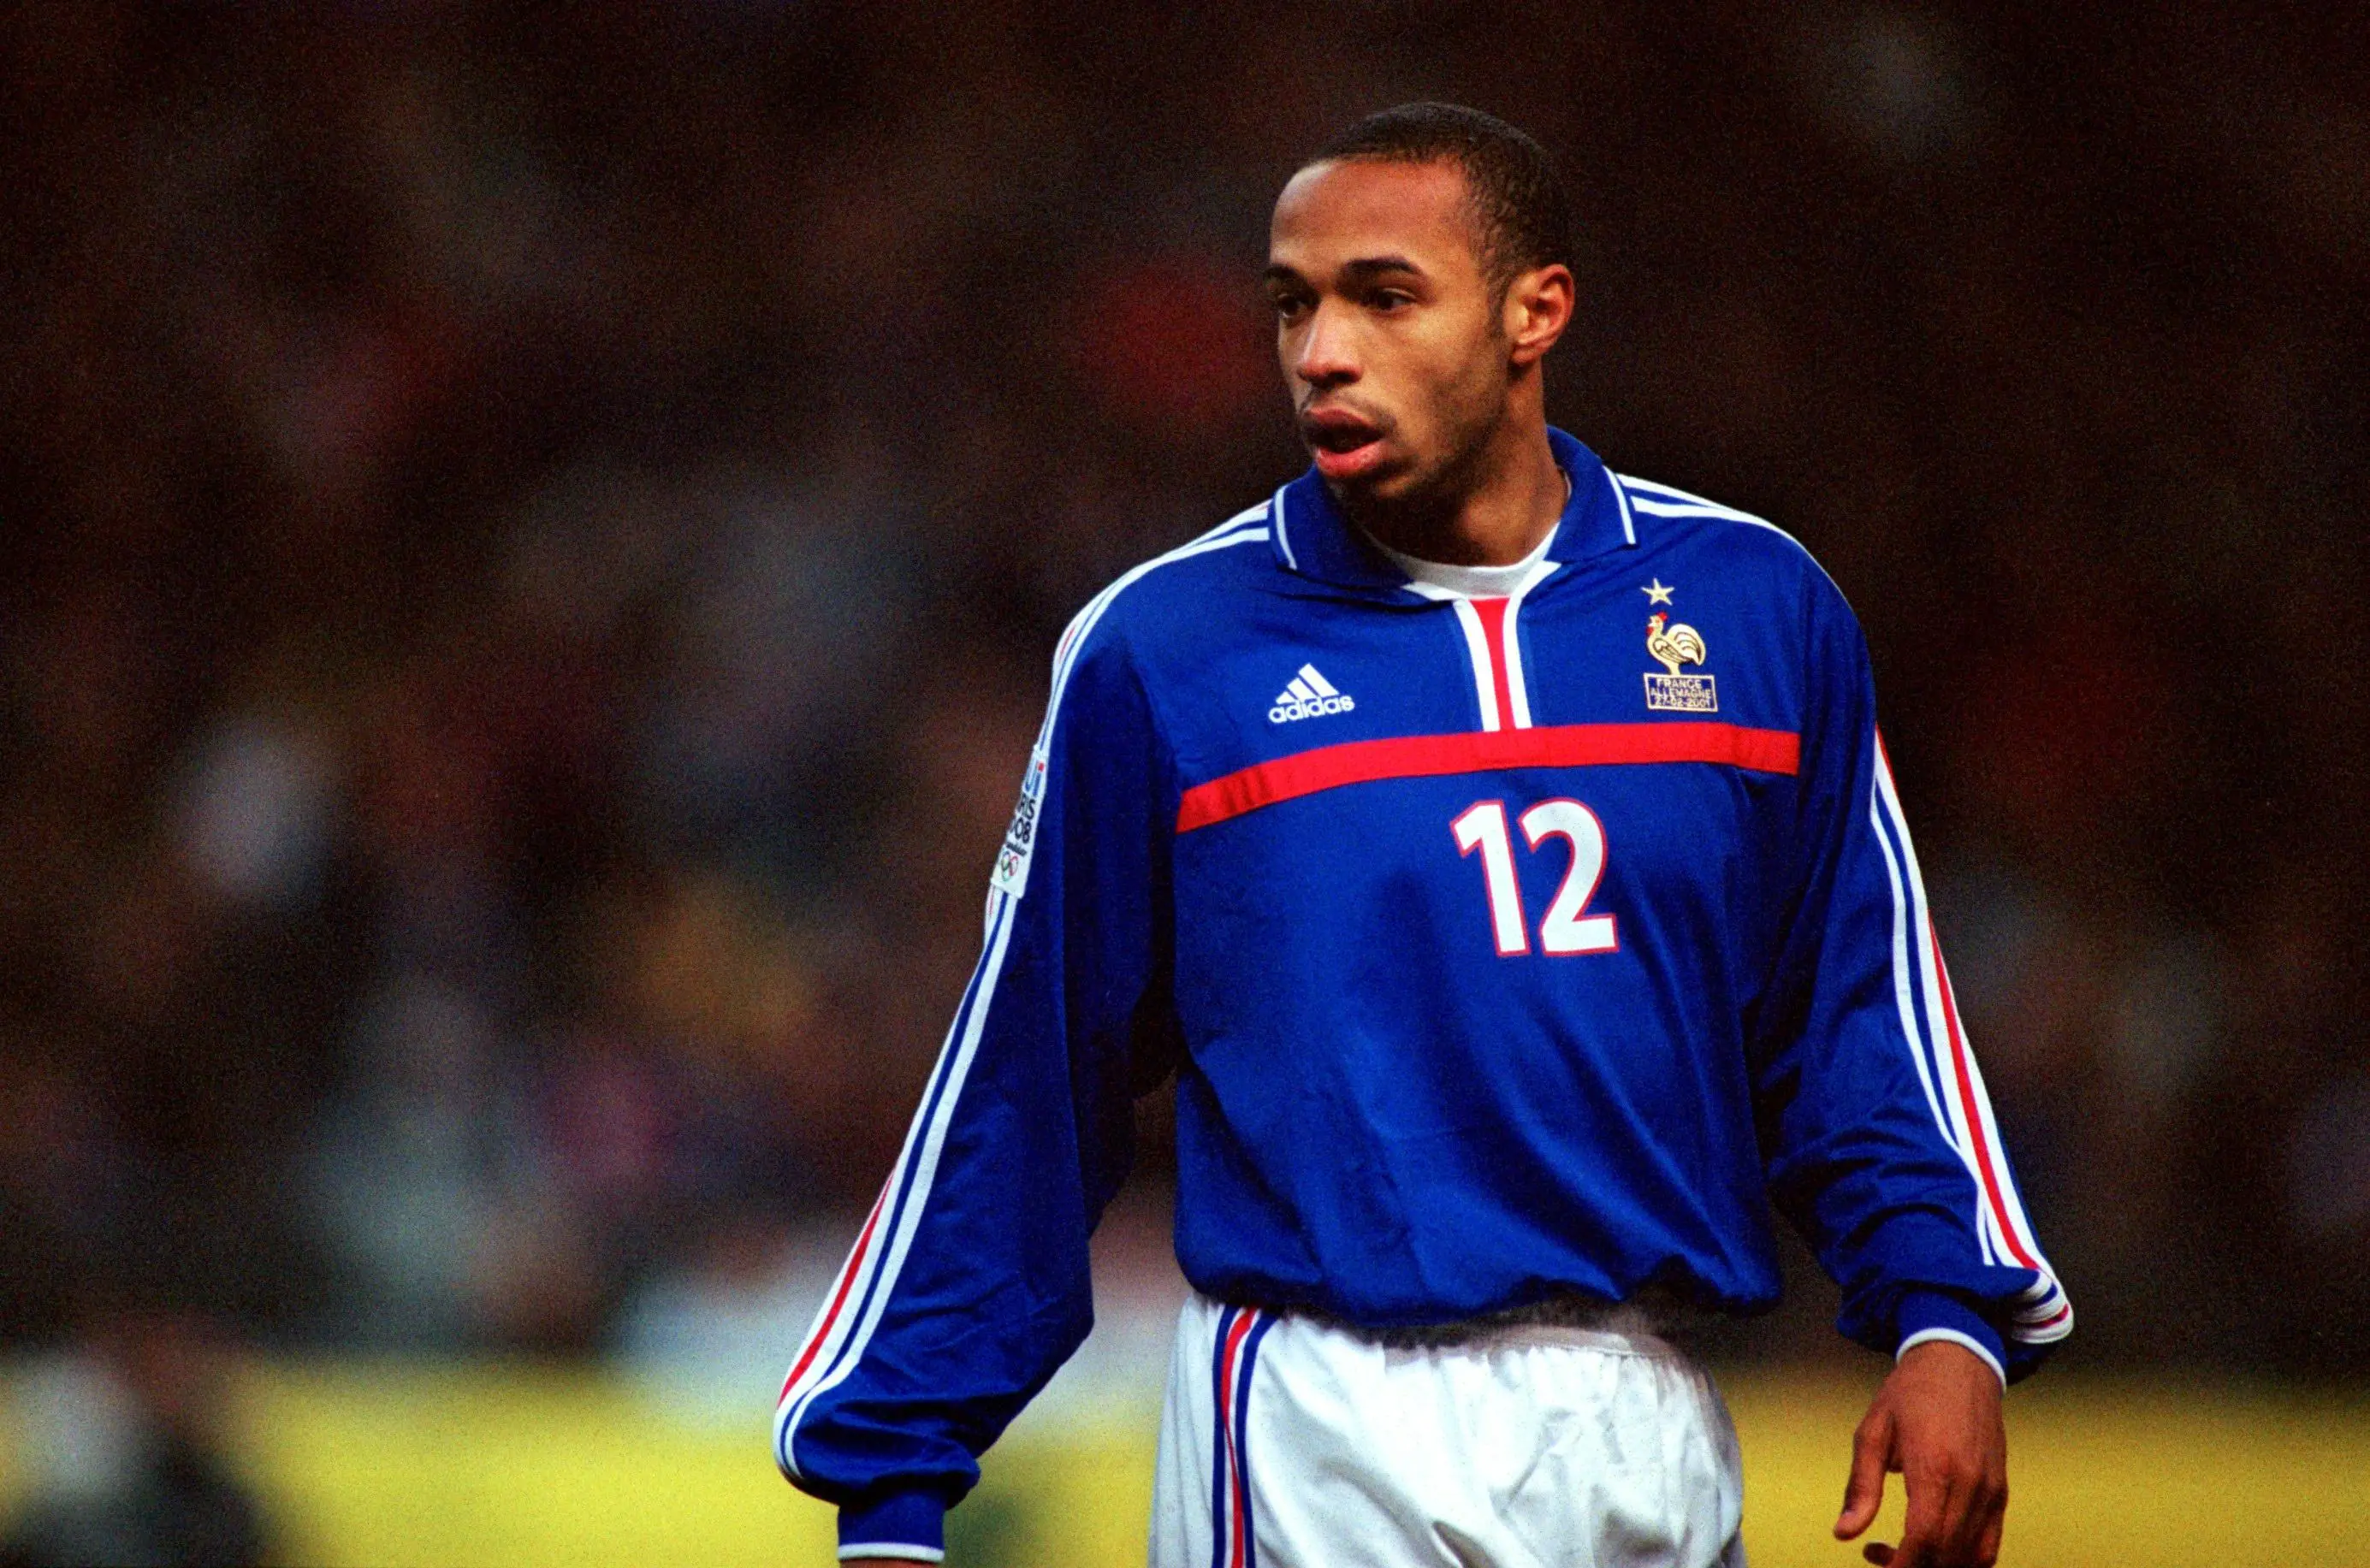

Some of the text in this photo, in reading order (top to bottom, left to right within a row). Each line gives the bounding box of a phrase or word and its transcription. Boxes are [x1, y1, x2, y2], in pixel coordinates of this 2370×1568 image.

[1650, 687, 1711, 699] ALLEMAGNE
[1656, 677, 1702, 689] FRANCE
[1268, 695, 1355, 724] adidas
[1449, 796, 1620, 957] 12
